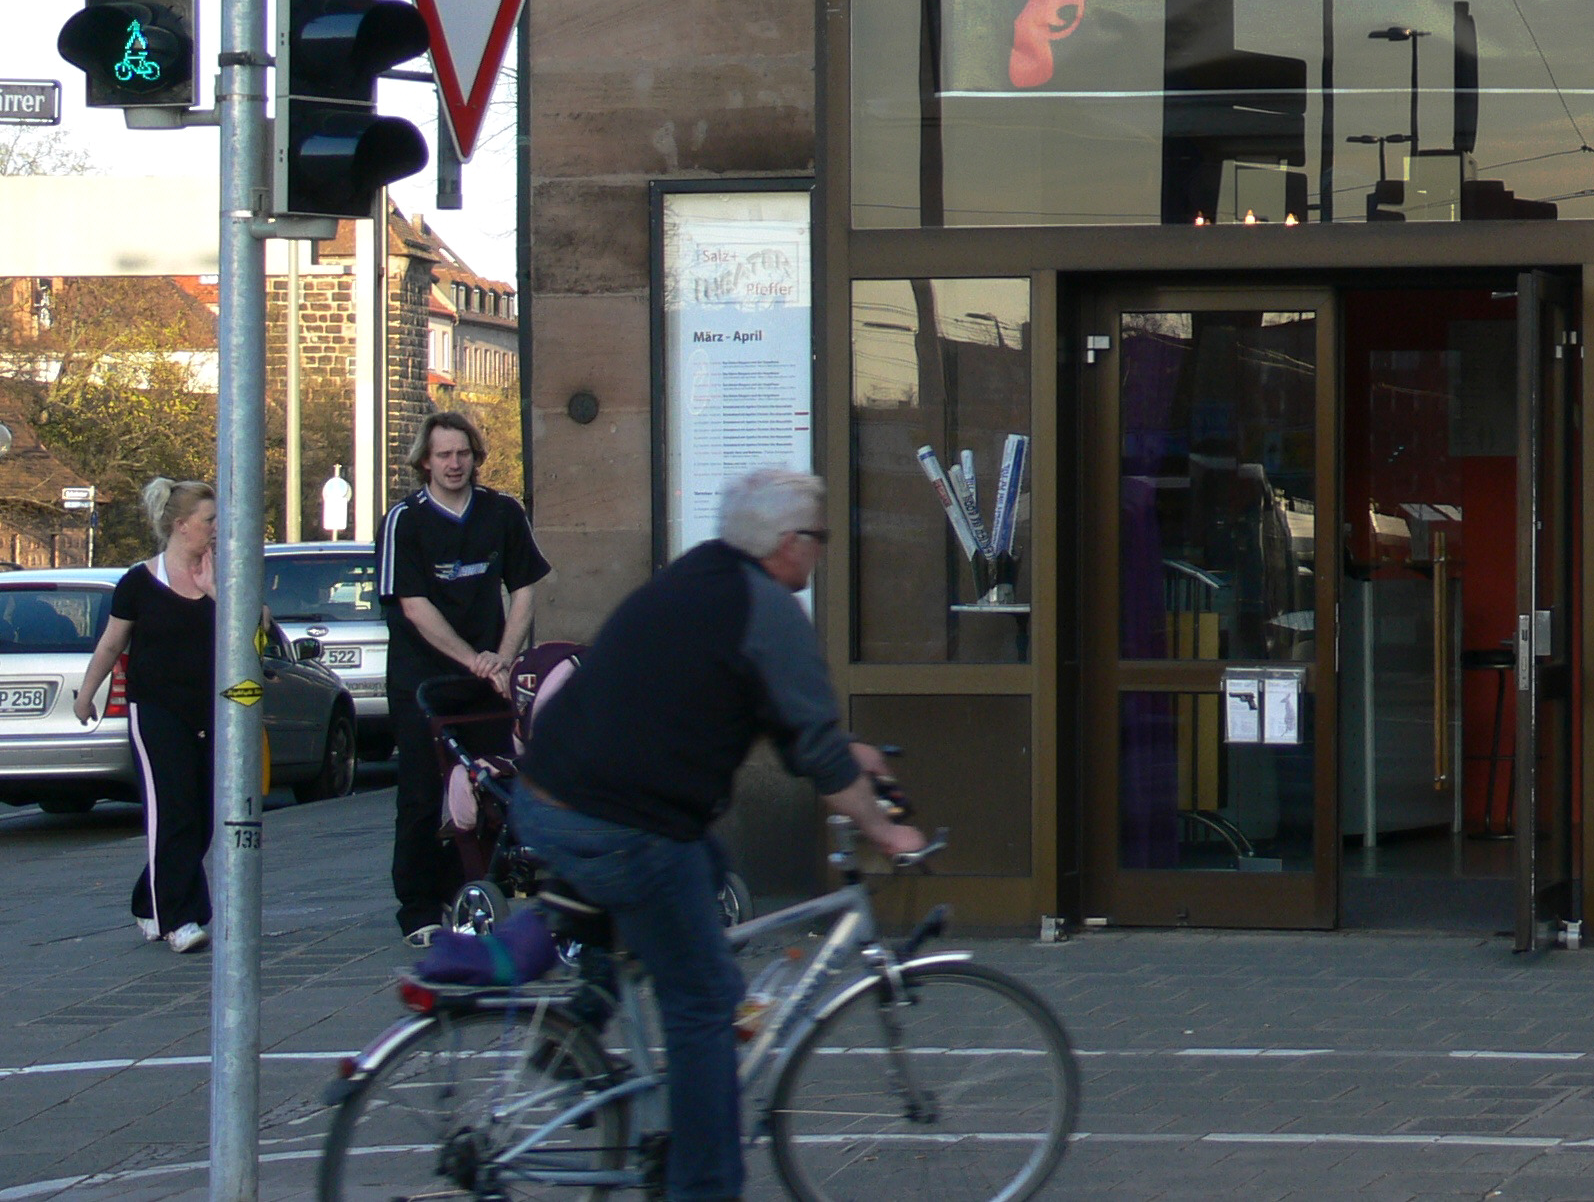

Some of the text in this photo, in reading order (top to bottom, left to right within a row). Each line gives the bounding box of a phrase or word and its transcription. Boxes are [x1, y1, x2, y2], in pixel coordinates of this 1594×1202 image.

[746, 283, 794, 296] Pfeffer
[693, 330, 724, 343] März
[733, 329, 763, 344] April
[329, 650, 356, 664] 522
[11, 690, 42, 706] 258
[244, 796, 253, 815] 1
